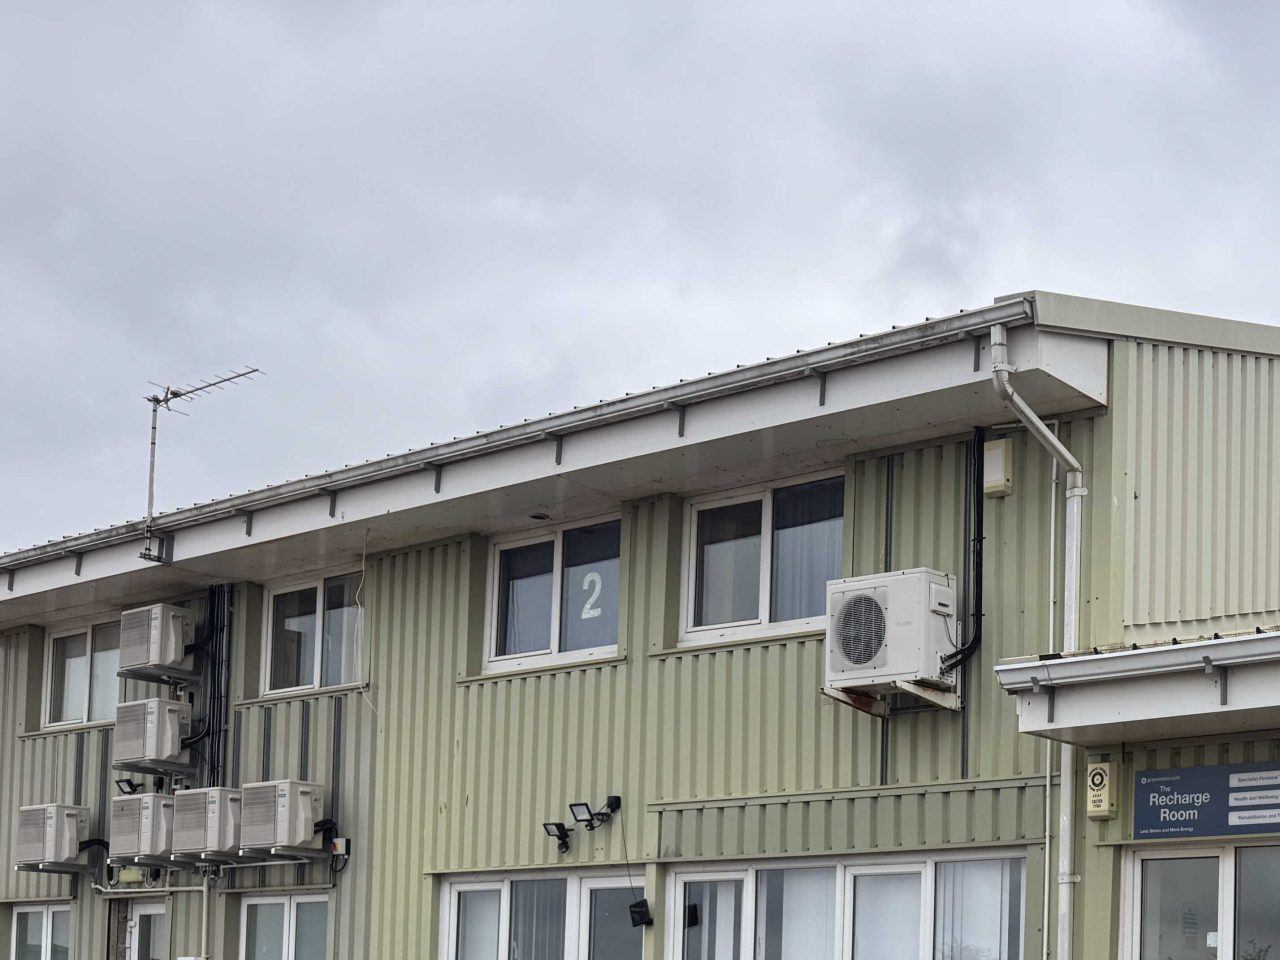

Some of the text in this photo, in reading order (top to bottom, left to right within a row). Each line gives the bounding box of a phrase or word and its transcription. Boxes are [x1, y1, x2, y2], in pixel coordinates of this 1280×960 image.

[581, 572, 602, 619] 2
[1149, 791, 1211, 806] Recharge
[1160, 808, 1198, 821] Room
